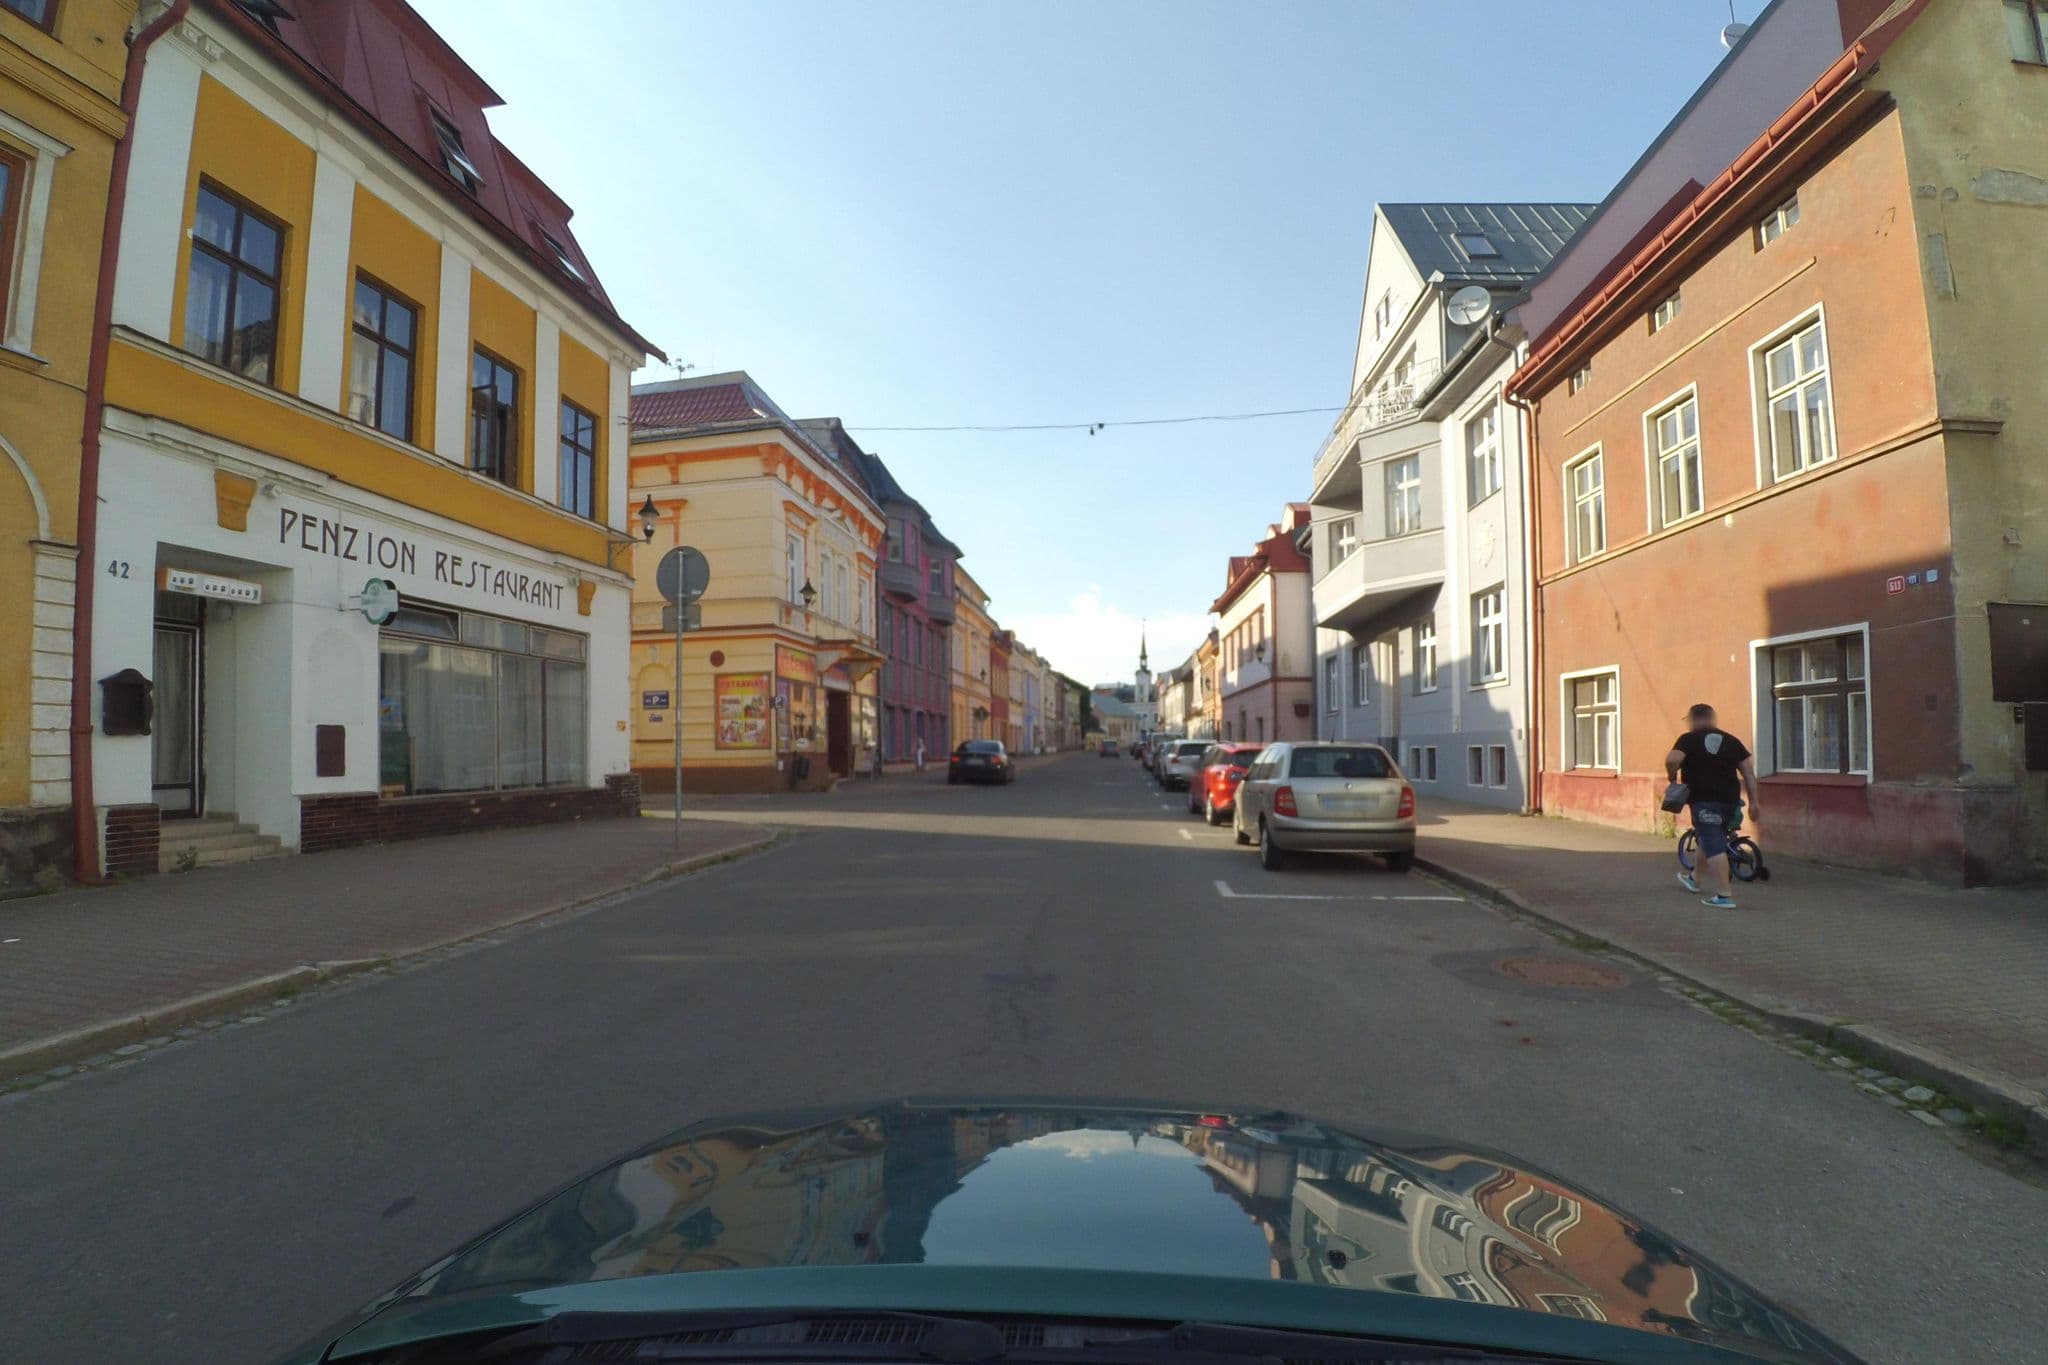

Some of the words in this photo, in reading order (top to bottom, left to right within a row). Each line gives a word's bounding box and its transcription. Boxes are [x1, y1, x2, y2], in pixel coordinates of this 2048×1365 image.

[108, 559, 130, 579] 42
[279, 508, 415, 576] PENZION
[435, 550, 565, 611] RESTAURANT
